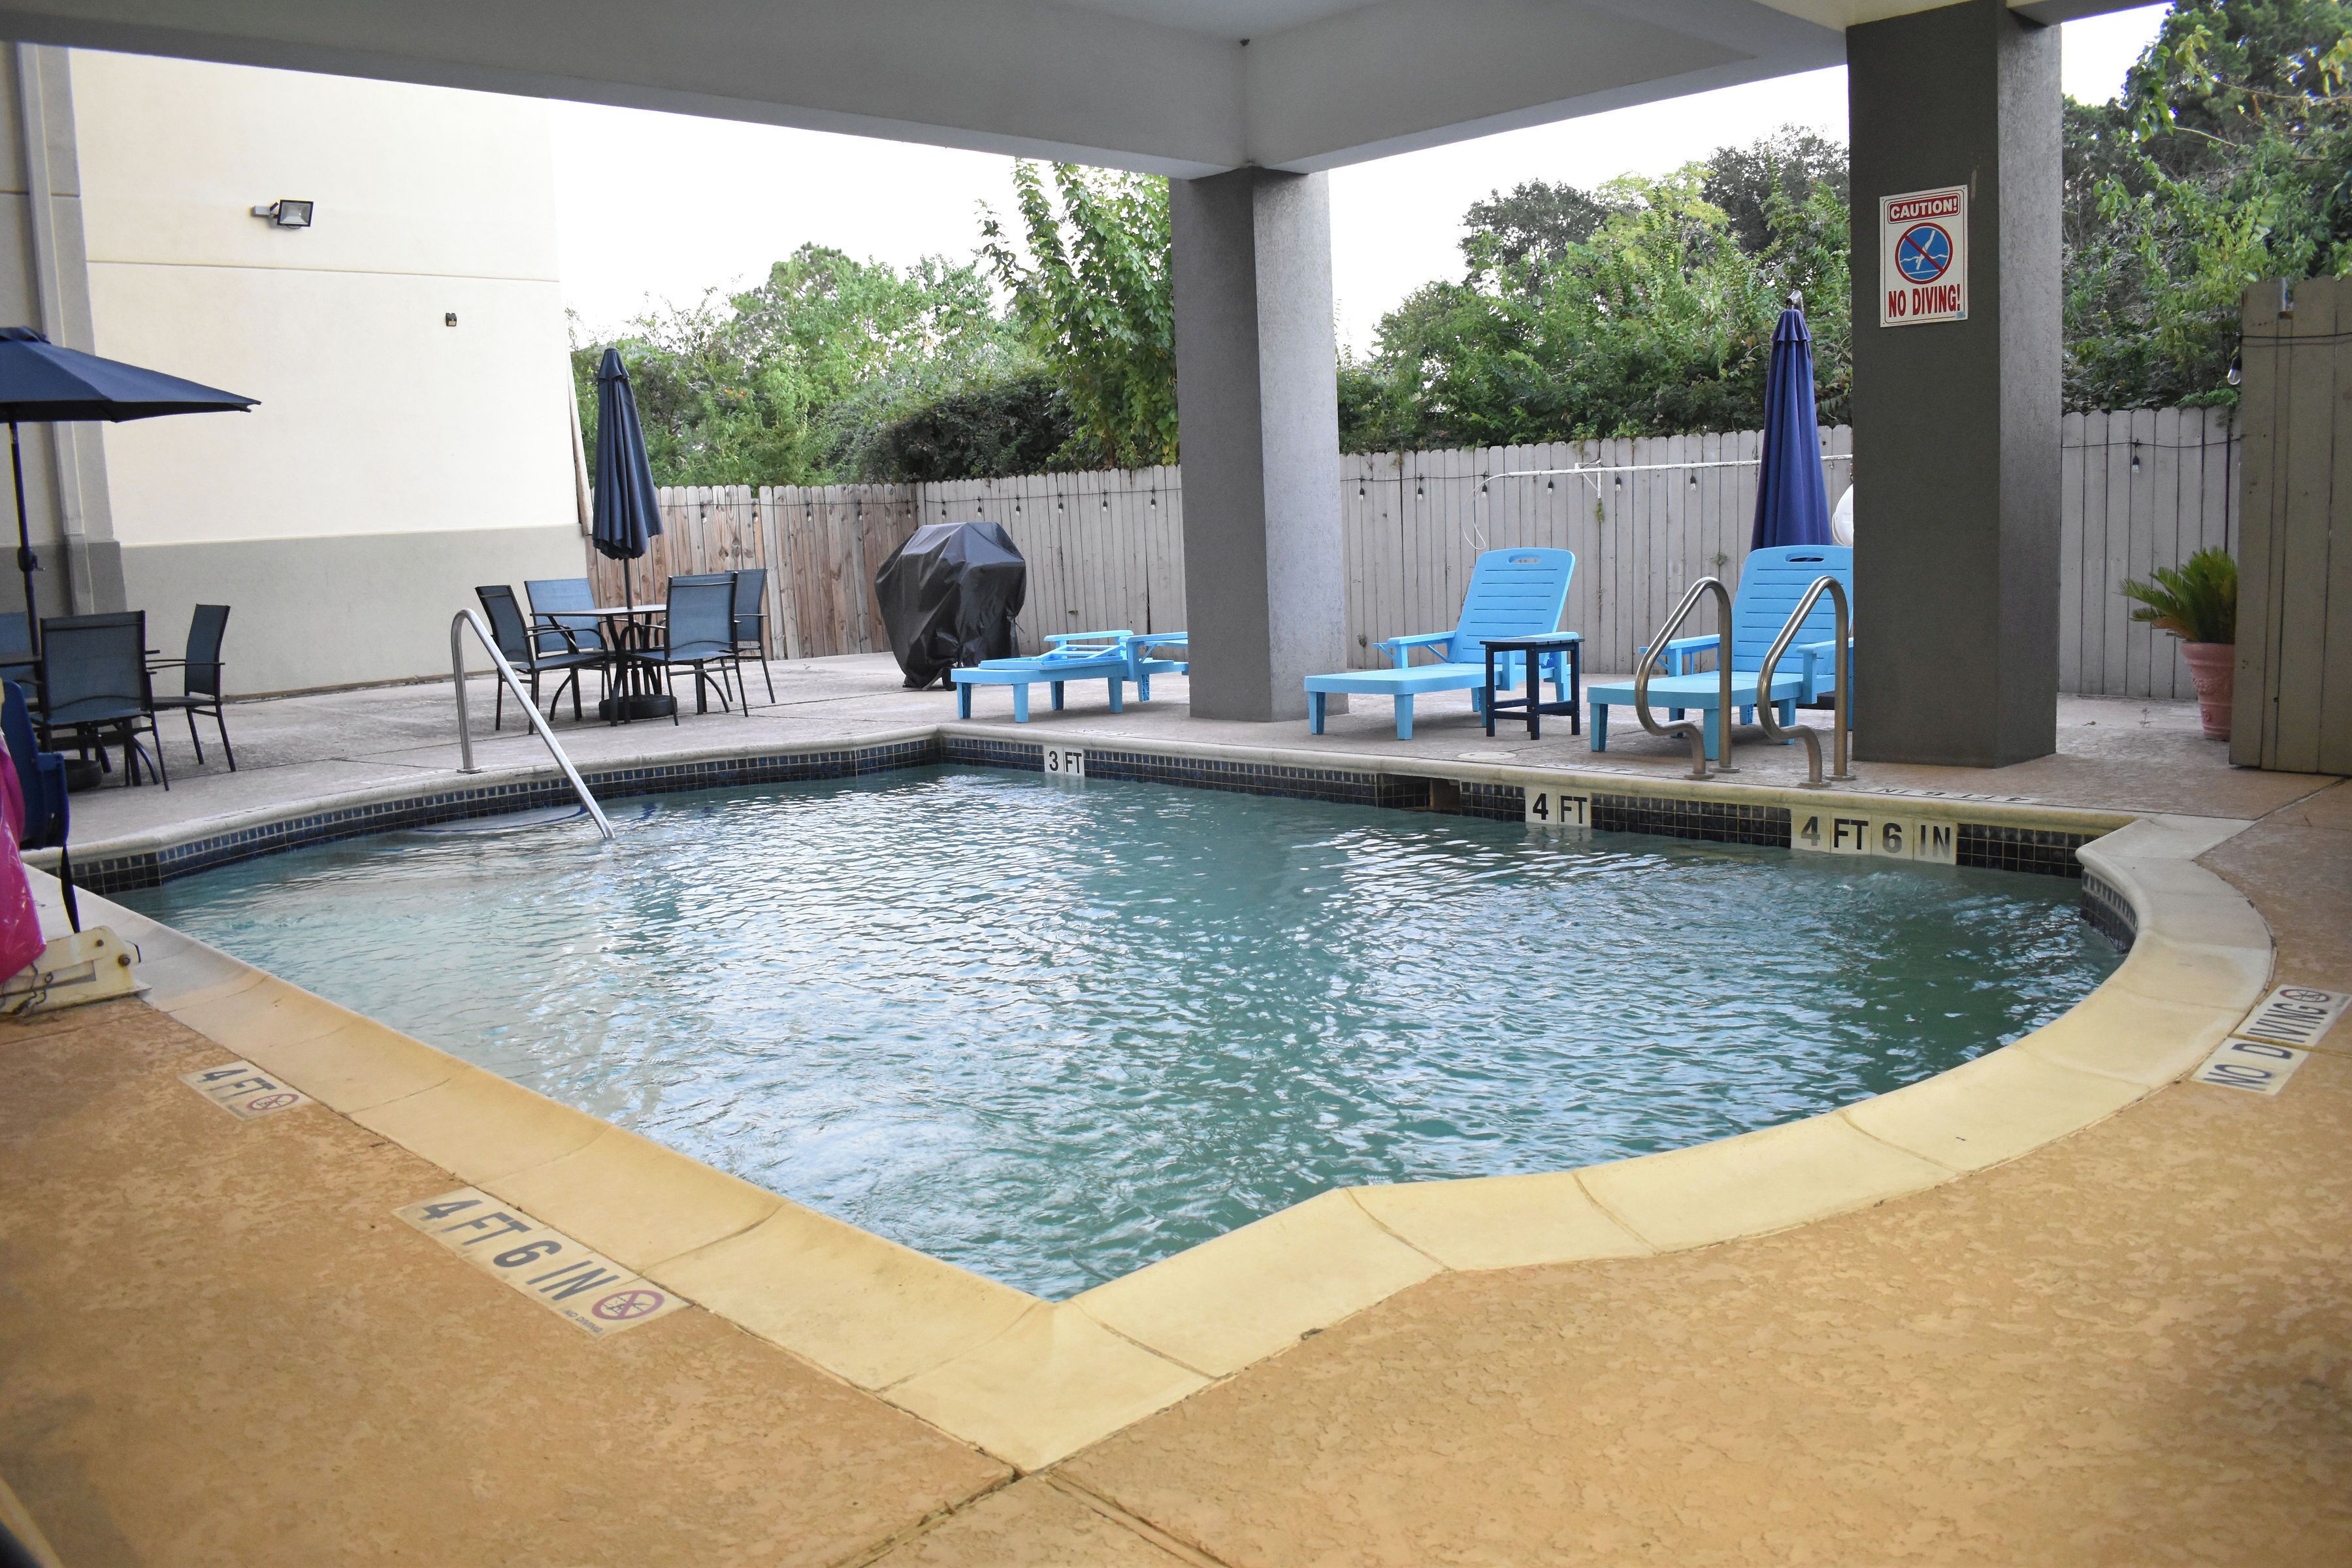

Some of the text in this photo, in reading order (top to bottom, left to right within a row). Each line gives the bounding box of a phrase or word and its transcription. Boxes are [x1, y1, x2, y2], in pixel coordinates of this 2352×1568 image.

[1890, 199, 1957, 220] CAUTION!
[1889, 284, 1960, 318] NO DIVING!
[1049, 751, 1082, 774] 3 FT
[1533, 793, 1587, 824] 4 FT
[1801, 816, 1950, 858] 4 FT 6 IN
[2203, 1003, 2328, 1091] NO DIVING
[197, 1069, 278, 1100] 4 FT
[419, 1200, 621, 1301] 4 FT 6 IN
